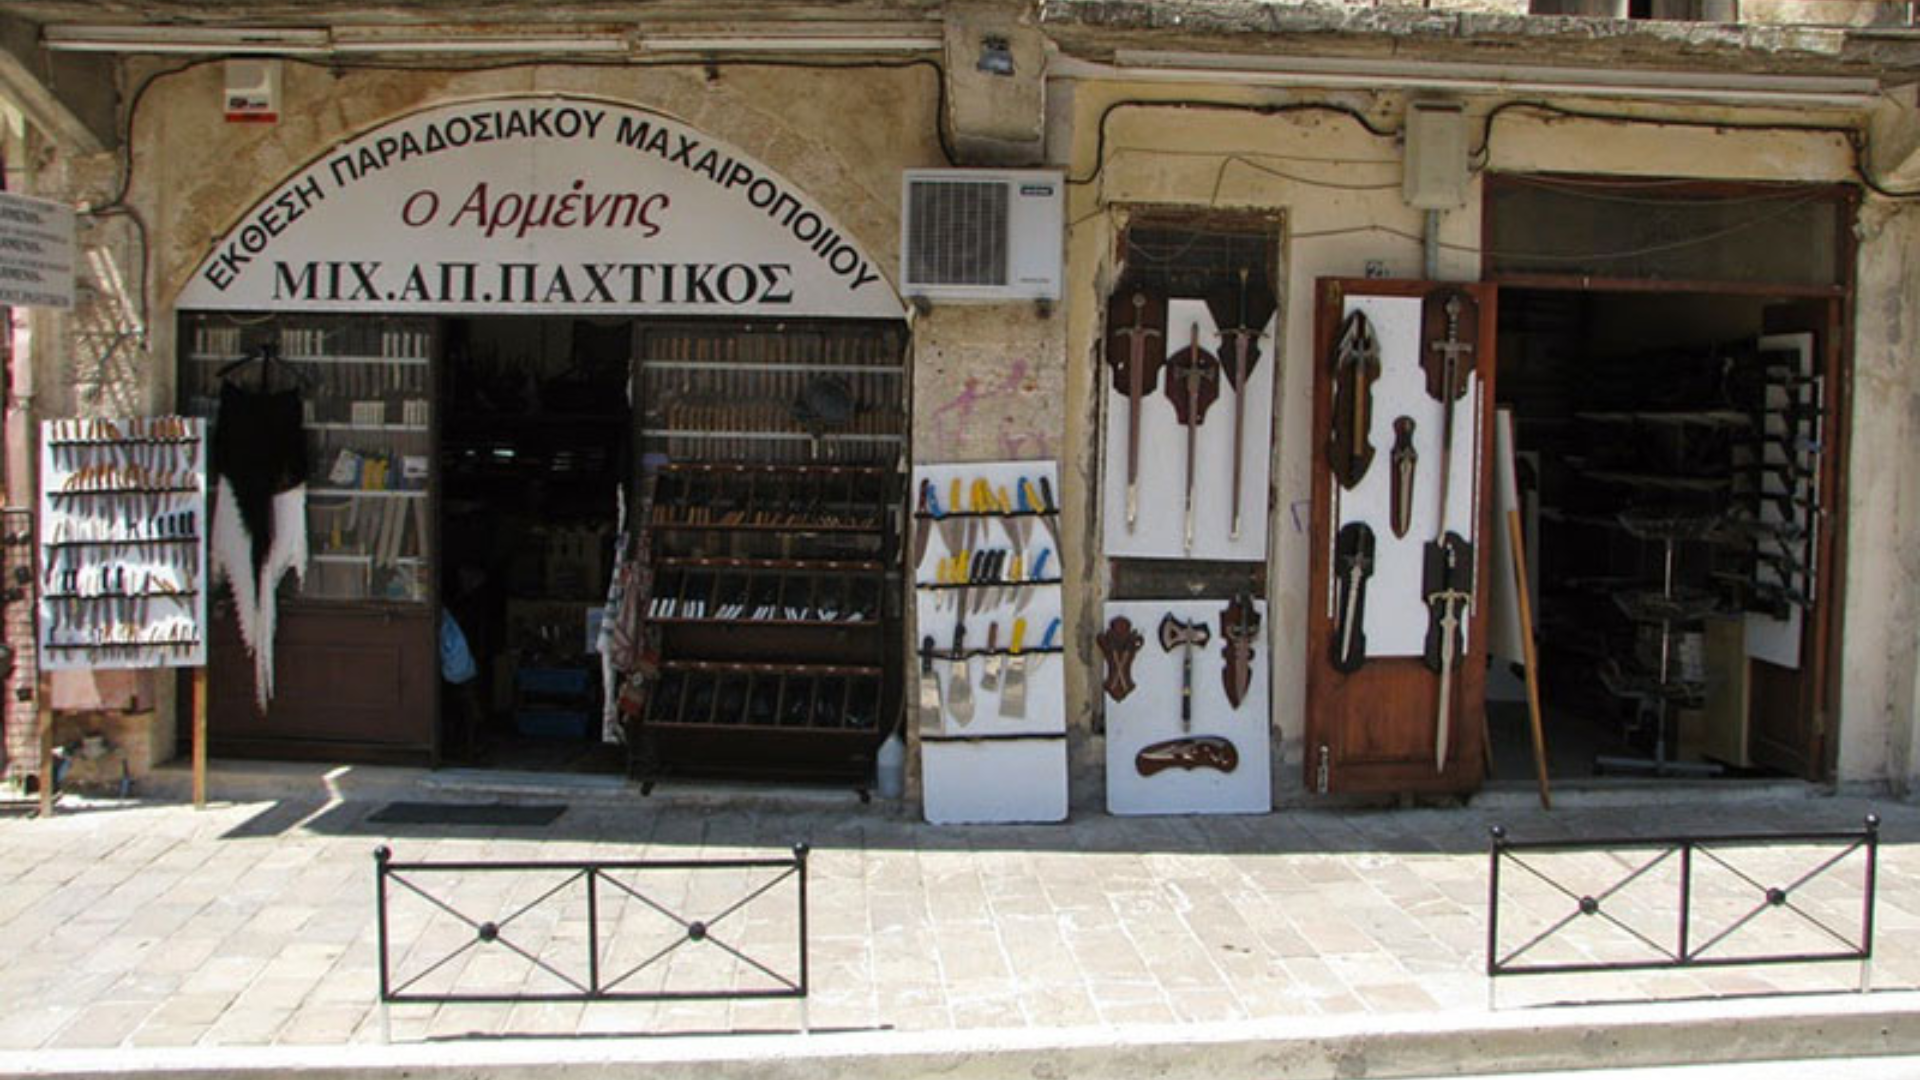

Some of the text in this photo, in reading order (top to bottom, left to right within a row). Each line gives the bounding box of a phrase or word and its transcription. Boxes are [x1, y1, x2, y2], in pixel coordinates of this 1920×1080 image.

[204, 108, 880, 292] ΕΚΘΕΣΗ ΠΑΡΑΔΟΣΙΑΚΟΥ ΜΑΧΑΙΡΟΠΟΙΙΟΥ
[448, 180, 670, 239] Αρμένης
